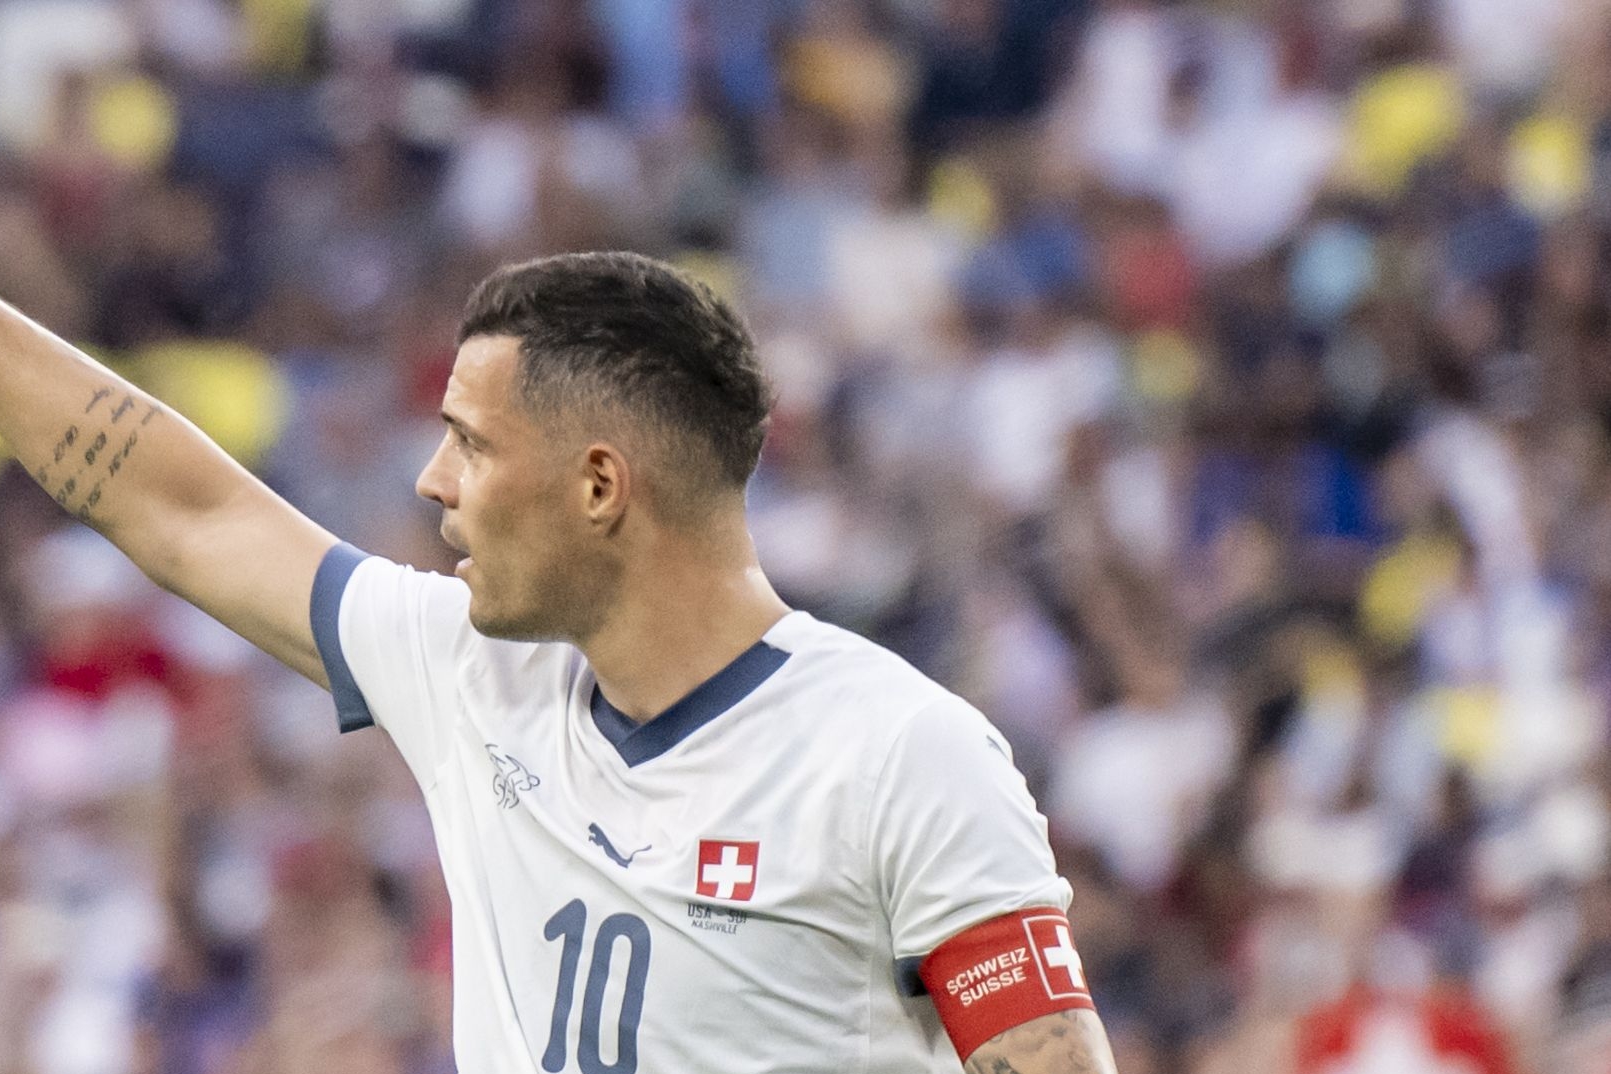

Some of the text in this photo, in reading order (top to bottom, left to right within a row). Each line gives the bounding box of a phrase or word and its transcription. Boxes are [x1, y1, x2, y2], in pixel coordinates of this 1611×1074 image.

[687, 903, 711, 919] USA
[946, 947, 1030, 995] SCHWEIZ
[960, 966, 1027, 1007] SUISSE
